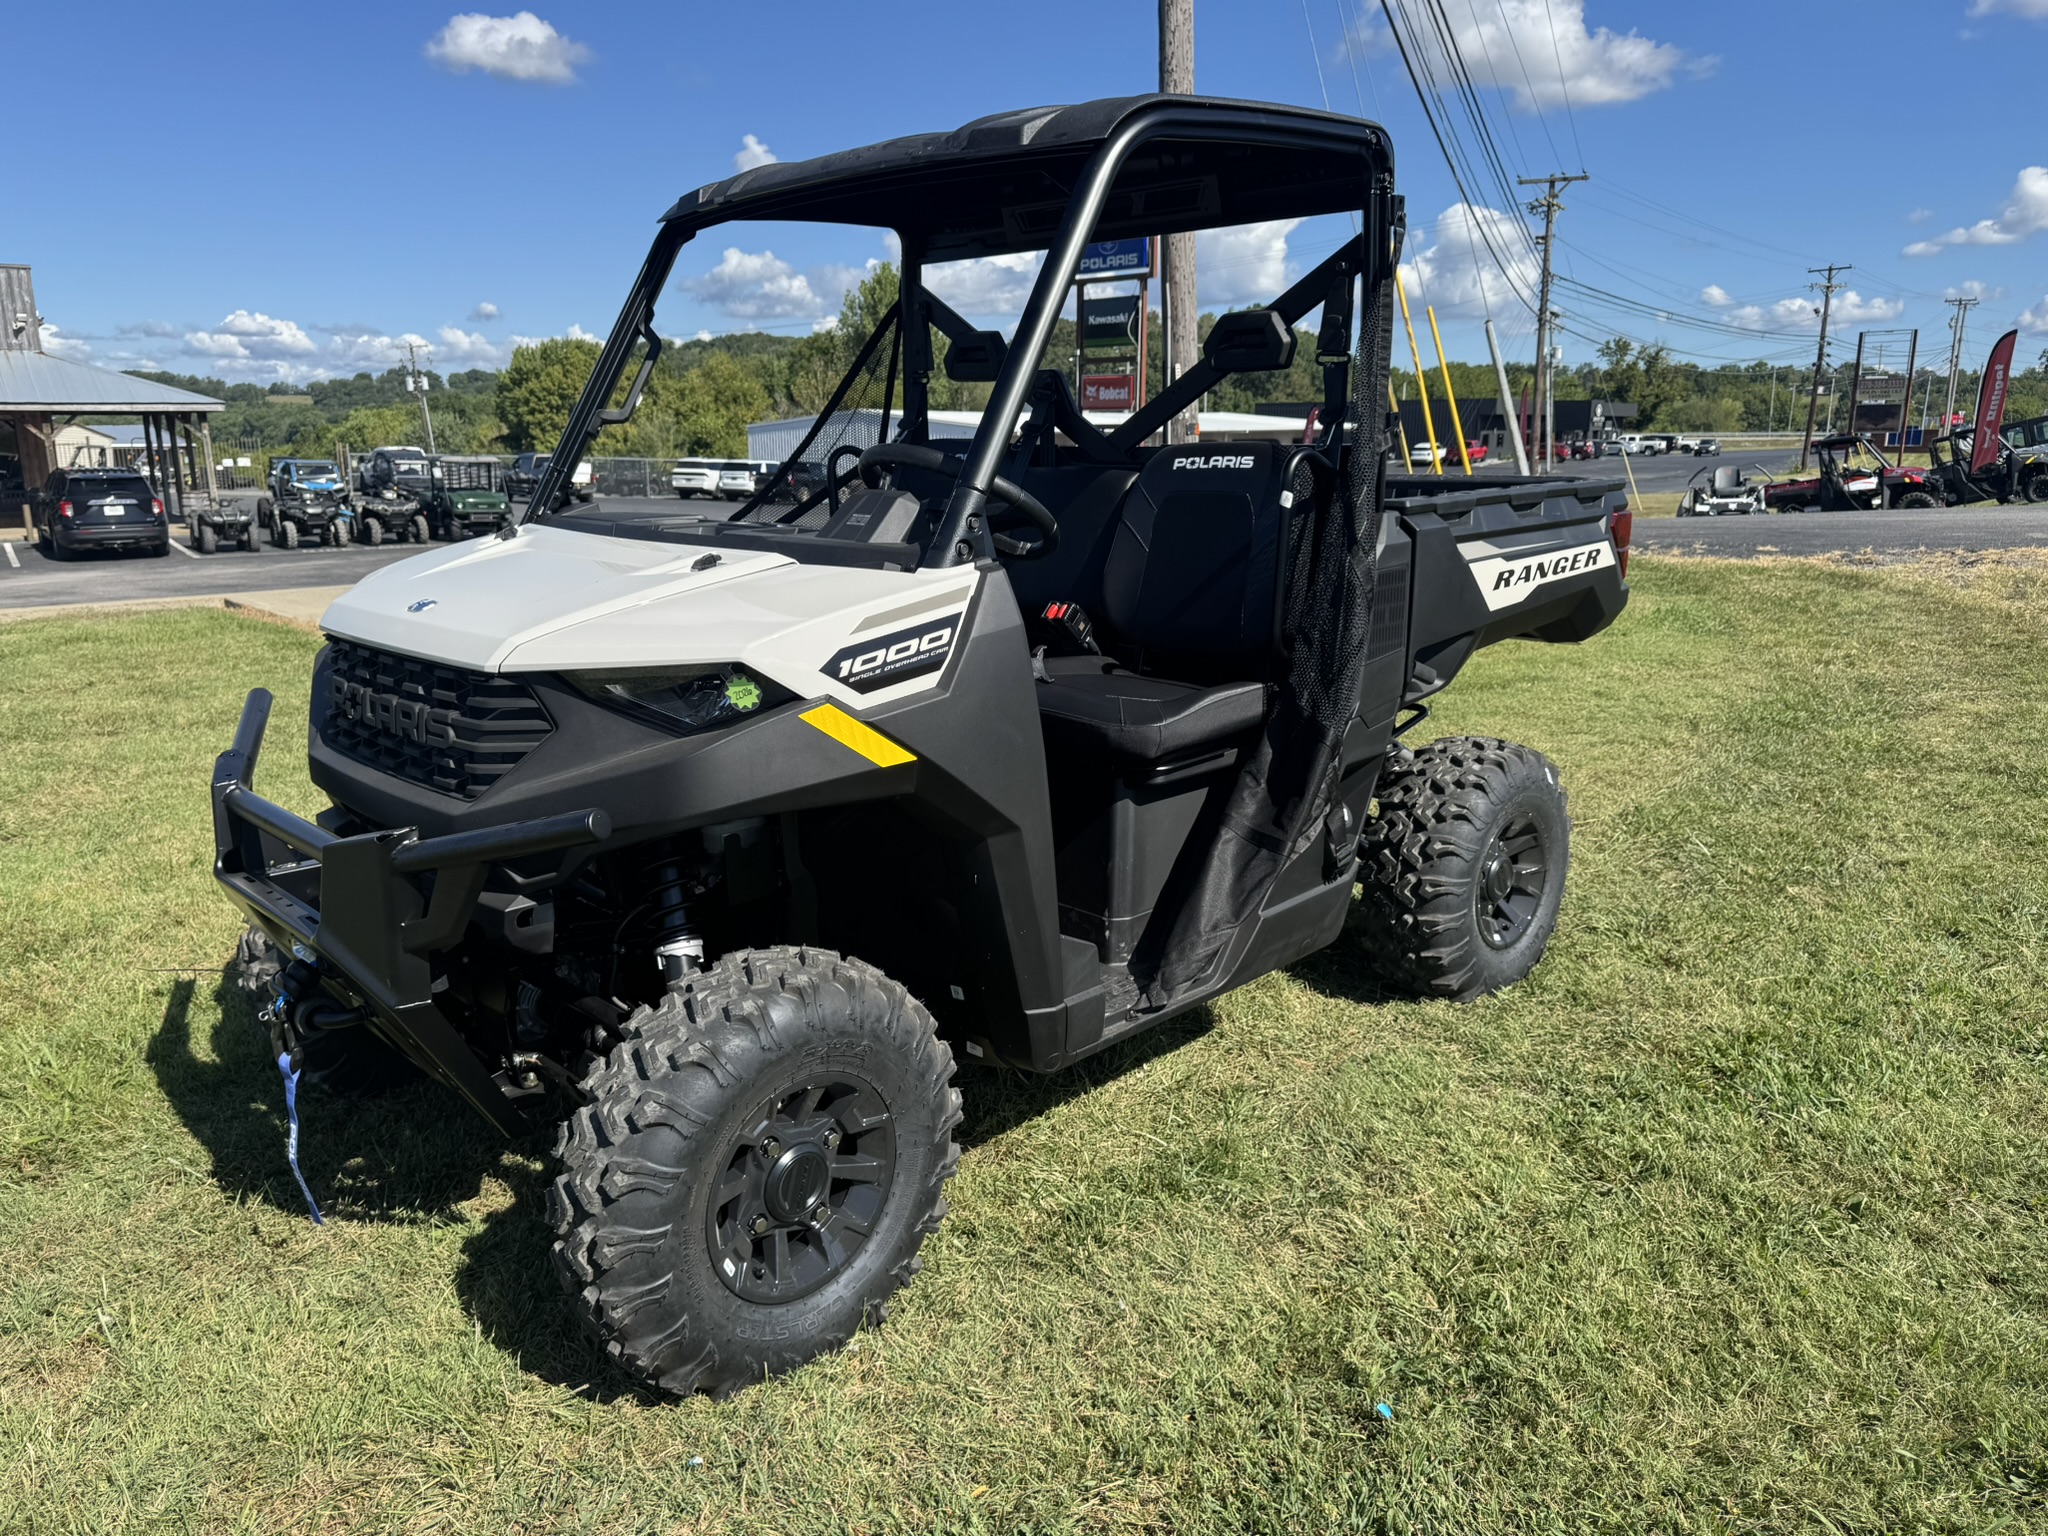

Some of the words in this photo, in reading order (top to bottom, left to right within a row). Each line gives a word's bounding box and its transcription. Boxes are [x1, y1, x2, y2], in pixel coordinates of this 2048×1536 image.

[1080, 254, 1138, 270] POLARIS
[1088, 312, 1129, 325] Kawasaki
[1099, 386, 1129, 400] Bobcat
[1172, 456, 1255, 470] POLARIS
[1492, 549, 1601, 591] RANGER
[838, 627, 952, 678] 1000
[849, 668, 882, 682] SINGLE
[884, 652, 930, 672] OVERHEAD
[930, 646, 949, 656] CAM
[331, 675, 457, 749] POLARIS
